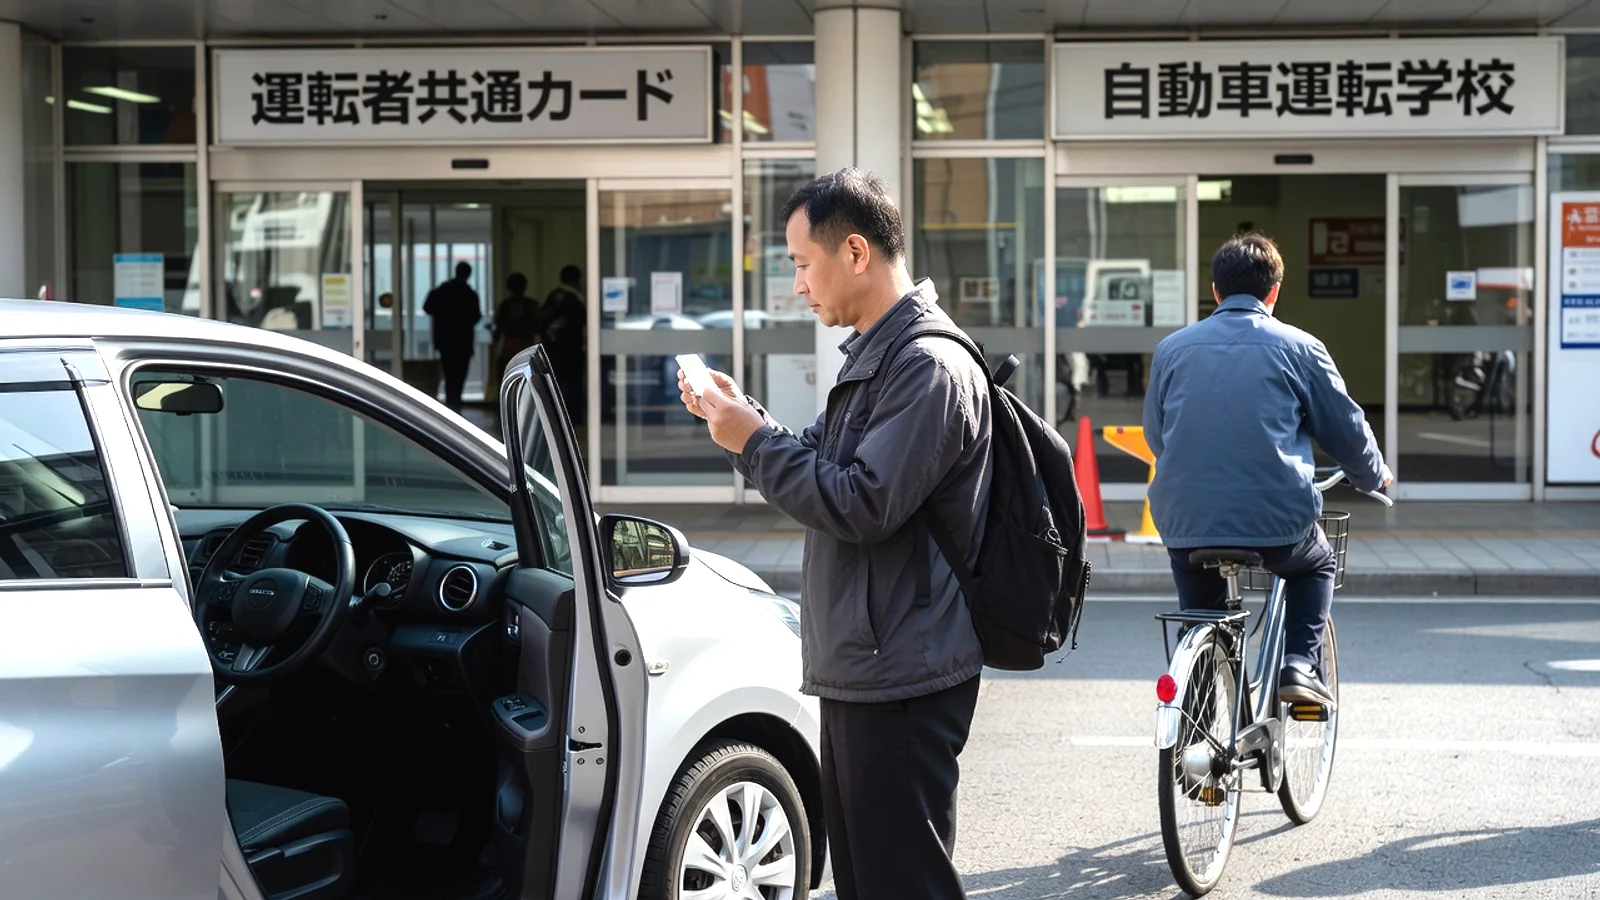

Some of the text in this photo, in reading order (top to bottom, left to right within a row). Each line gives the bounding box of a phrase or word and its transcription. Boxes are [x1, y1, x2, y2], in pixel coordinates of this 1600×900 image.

[251, 69, 674, 126] 運転者共通カード
[1104, 58, 1515, 119] 自動車運転学校
